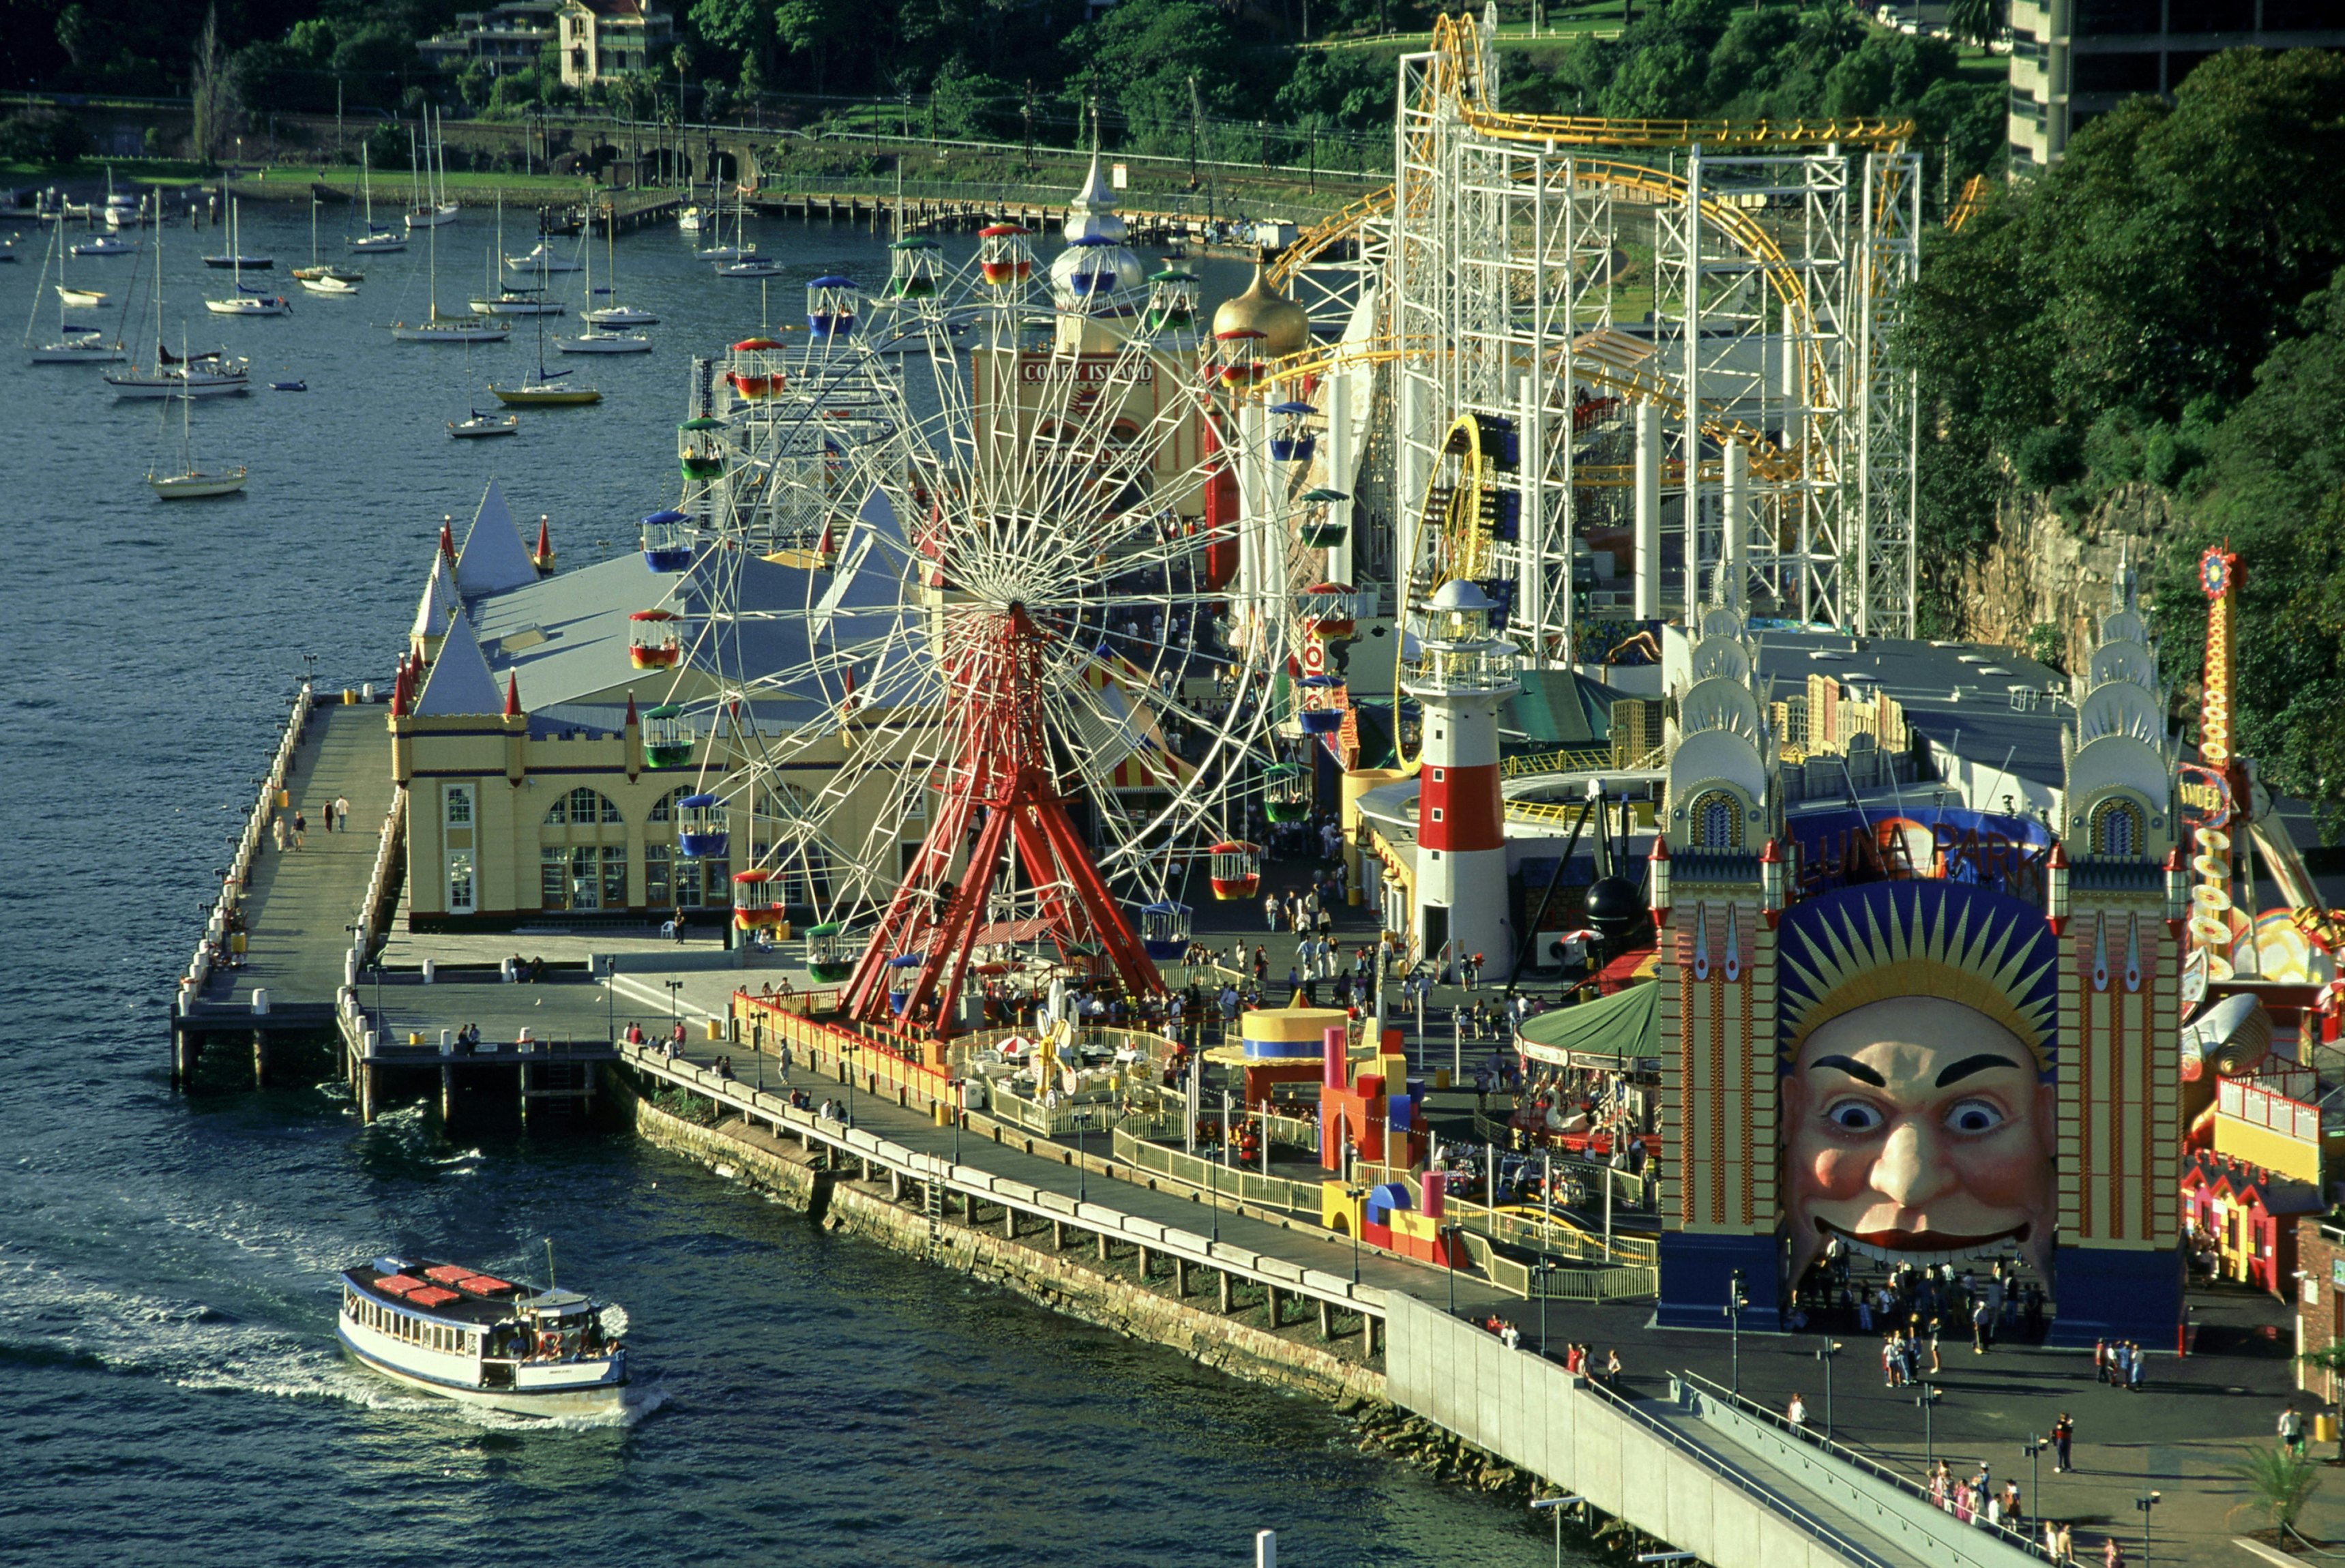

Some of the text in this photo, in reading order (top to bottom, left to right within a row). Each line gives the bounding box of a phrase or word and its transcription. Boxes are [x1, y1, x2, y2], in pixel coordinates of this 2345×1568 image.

[1024, 364, 1152, 381] CONEY ISLAND
[1796, 823, 2045, 895] LUNA PARK
